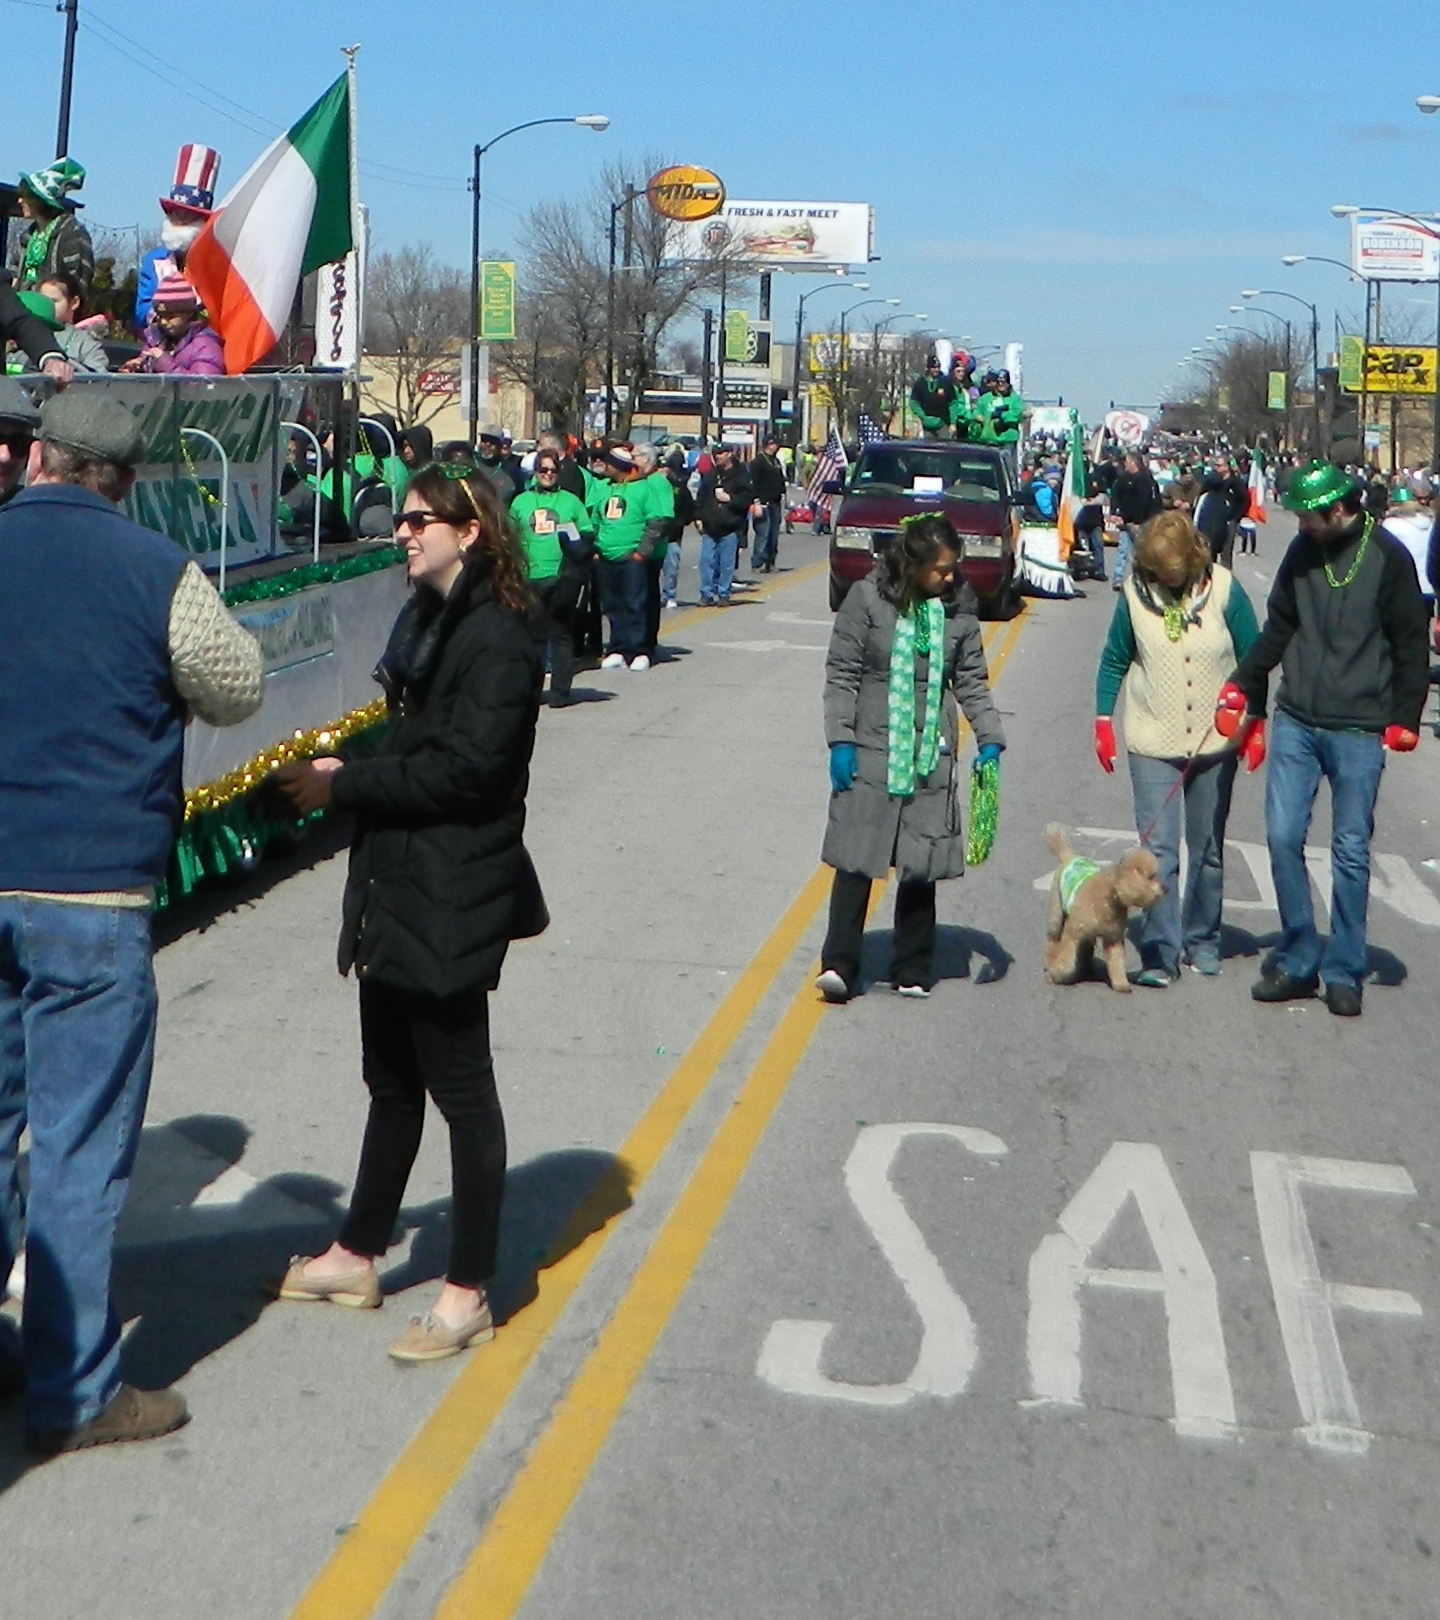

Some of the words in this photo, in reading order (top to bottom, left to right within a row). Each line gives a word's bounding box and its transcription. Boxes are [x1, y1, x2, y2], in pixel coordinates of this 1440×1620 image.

[727, 207, 763, 217] FRESH
[766, 208, 774, 217] &
[777, 208, 805, 218] FAST
[807, 209, 839, 219] MEET
